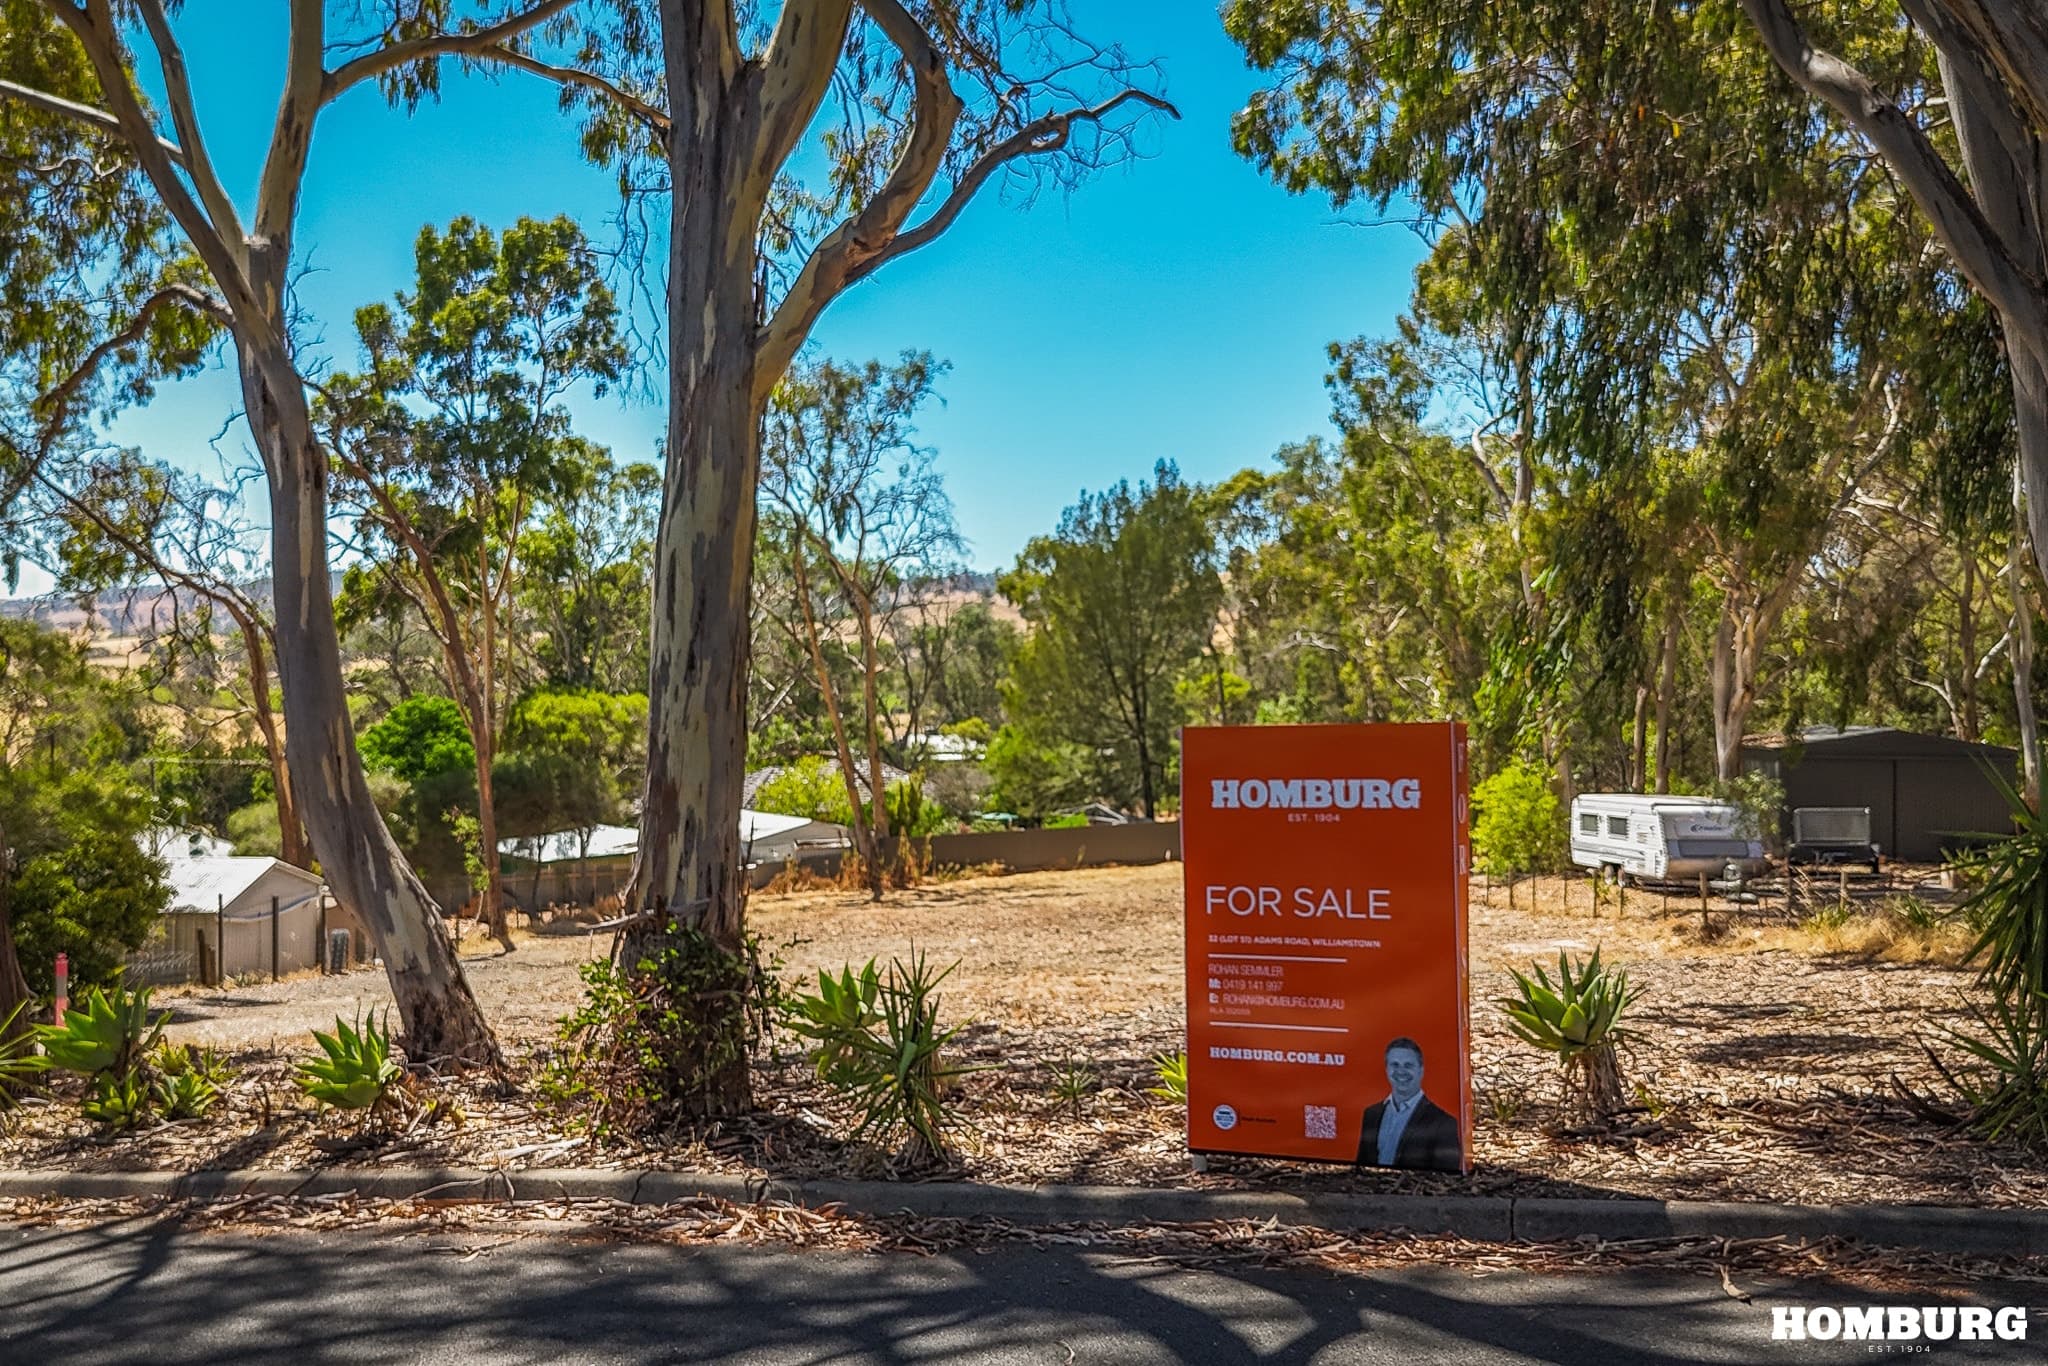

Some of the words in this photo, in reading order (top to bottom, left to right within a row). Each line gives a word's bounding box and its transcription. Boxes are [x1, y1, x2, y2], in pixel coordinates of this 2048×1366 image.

[1211, 778, 1421, 809] HOMBURG
[1287, 813, 1311, 822] EST.
[1314, 813, 1340, 822] 1904
[1205, 886, 1282, 917] FOR
[1294, 887, 1392, 920] SALE
[1253, 936, 1282, 945] ADAMS
[1312, 937, 1380, 948] WILLIAMSTOWN
[1208, 964, 1238, 975] ROHAN
[1241, 965, 1283, 976] SEMMLER
[1222, 979, 1245, 989] 0419
[1247, 980, 1263, 990] 141
[1209, 1046, 1344, 1065] HOMBURG.COM.AU
